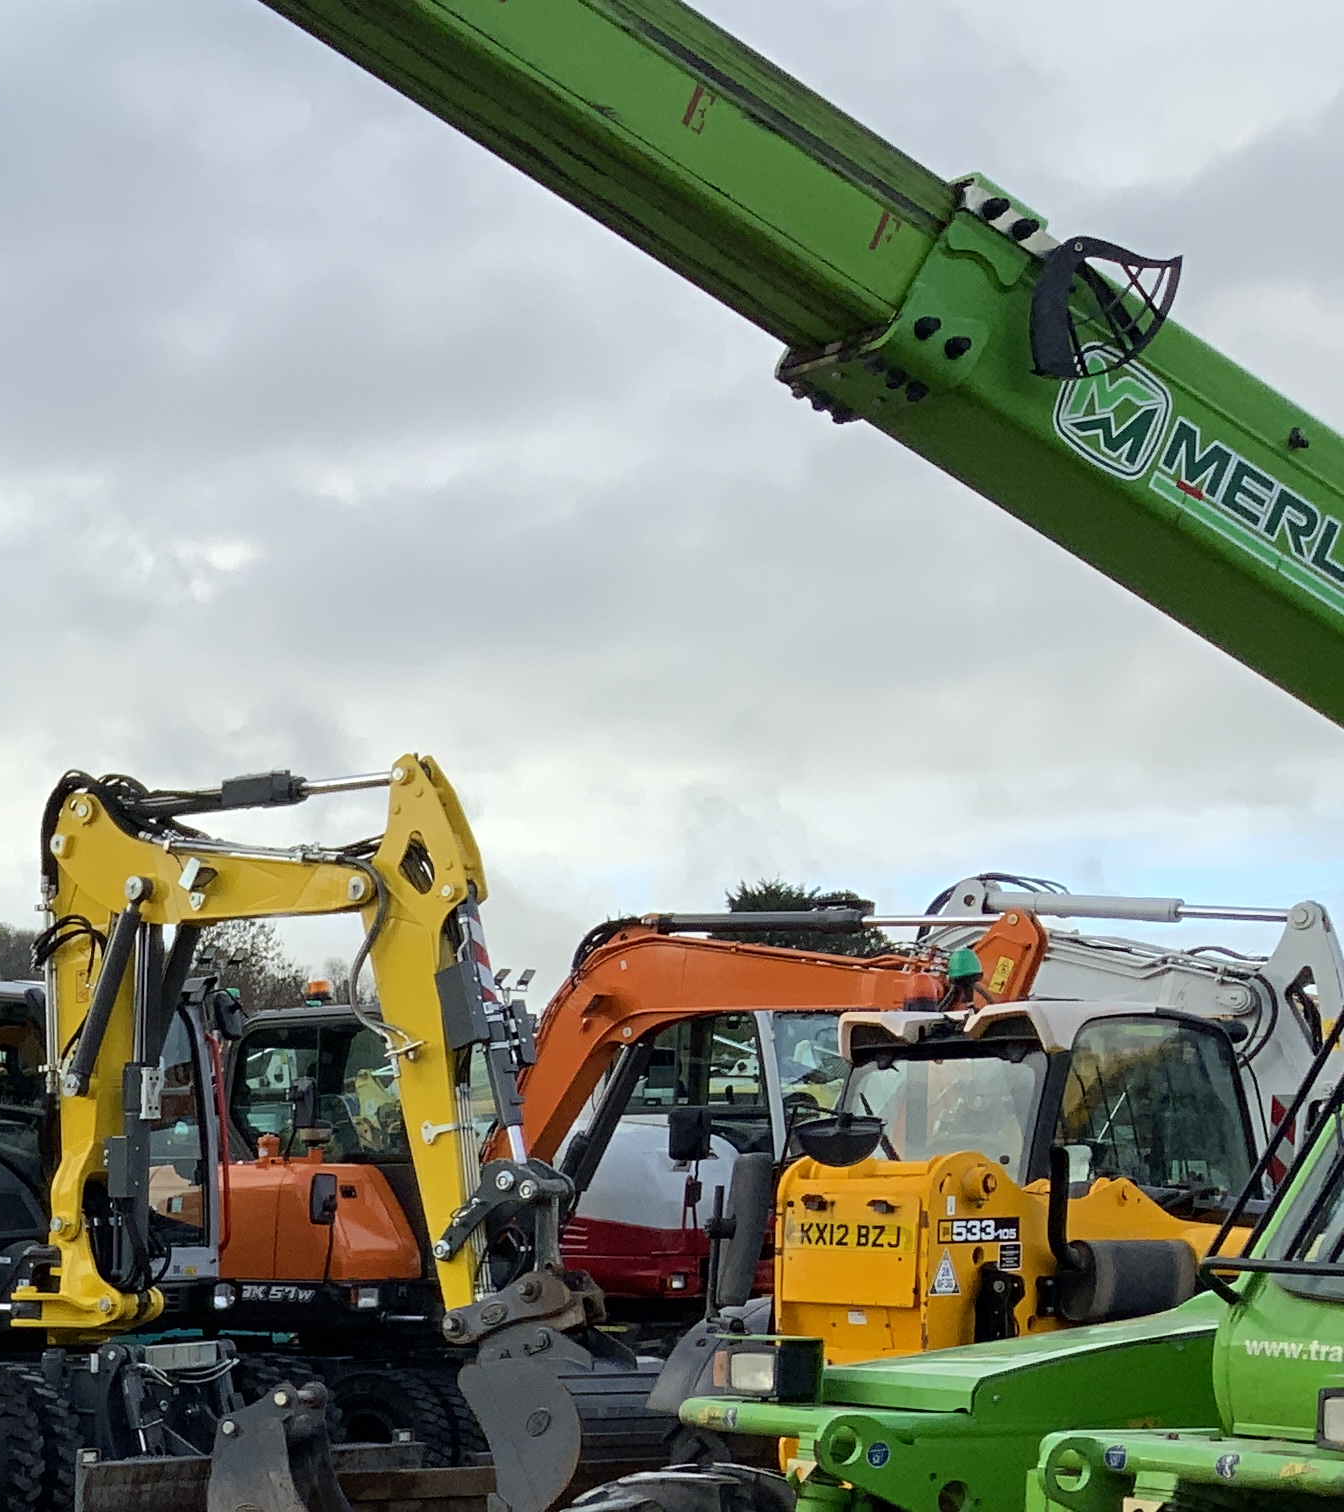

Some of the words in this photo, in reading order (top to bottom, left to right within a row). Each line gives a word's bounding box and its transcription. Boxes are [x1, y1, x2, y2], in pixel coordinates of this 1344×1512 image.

[800, 1222, 849, 1247] KX12
[856, 1224, 901, 1248] BZJ
[1244, 1339, 1344, 1363] www.tra
